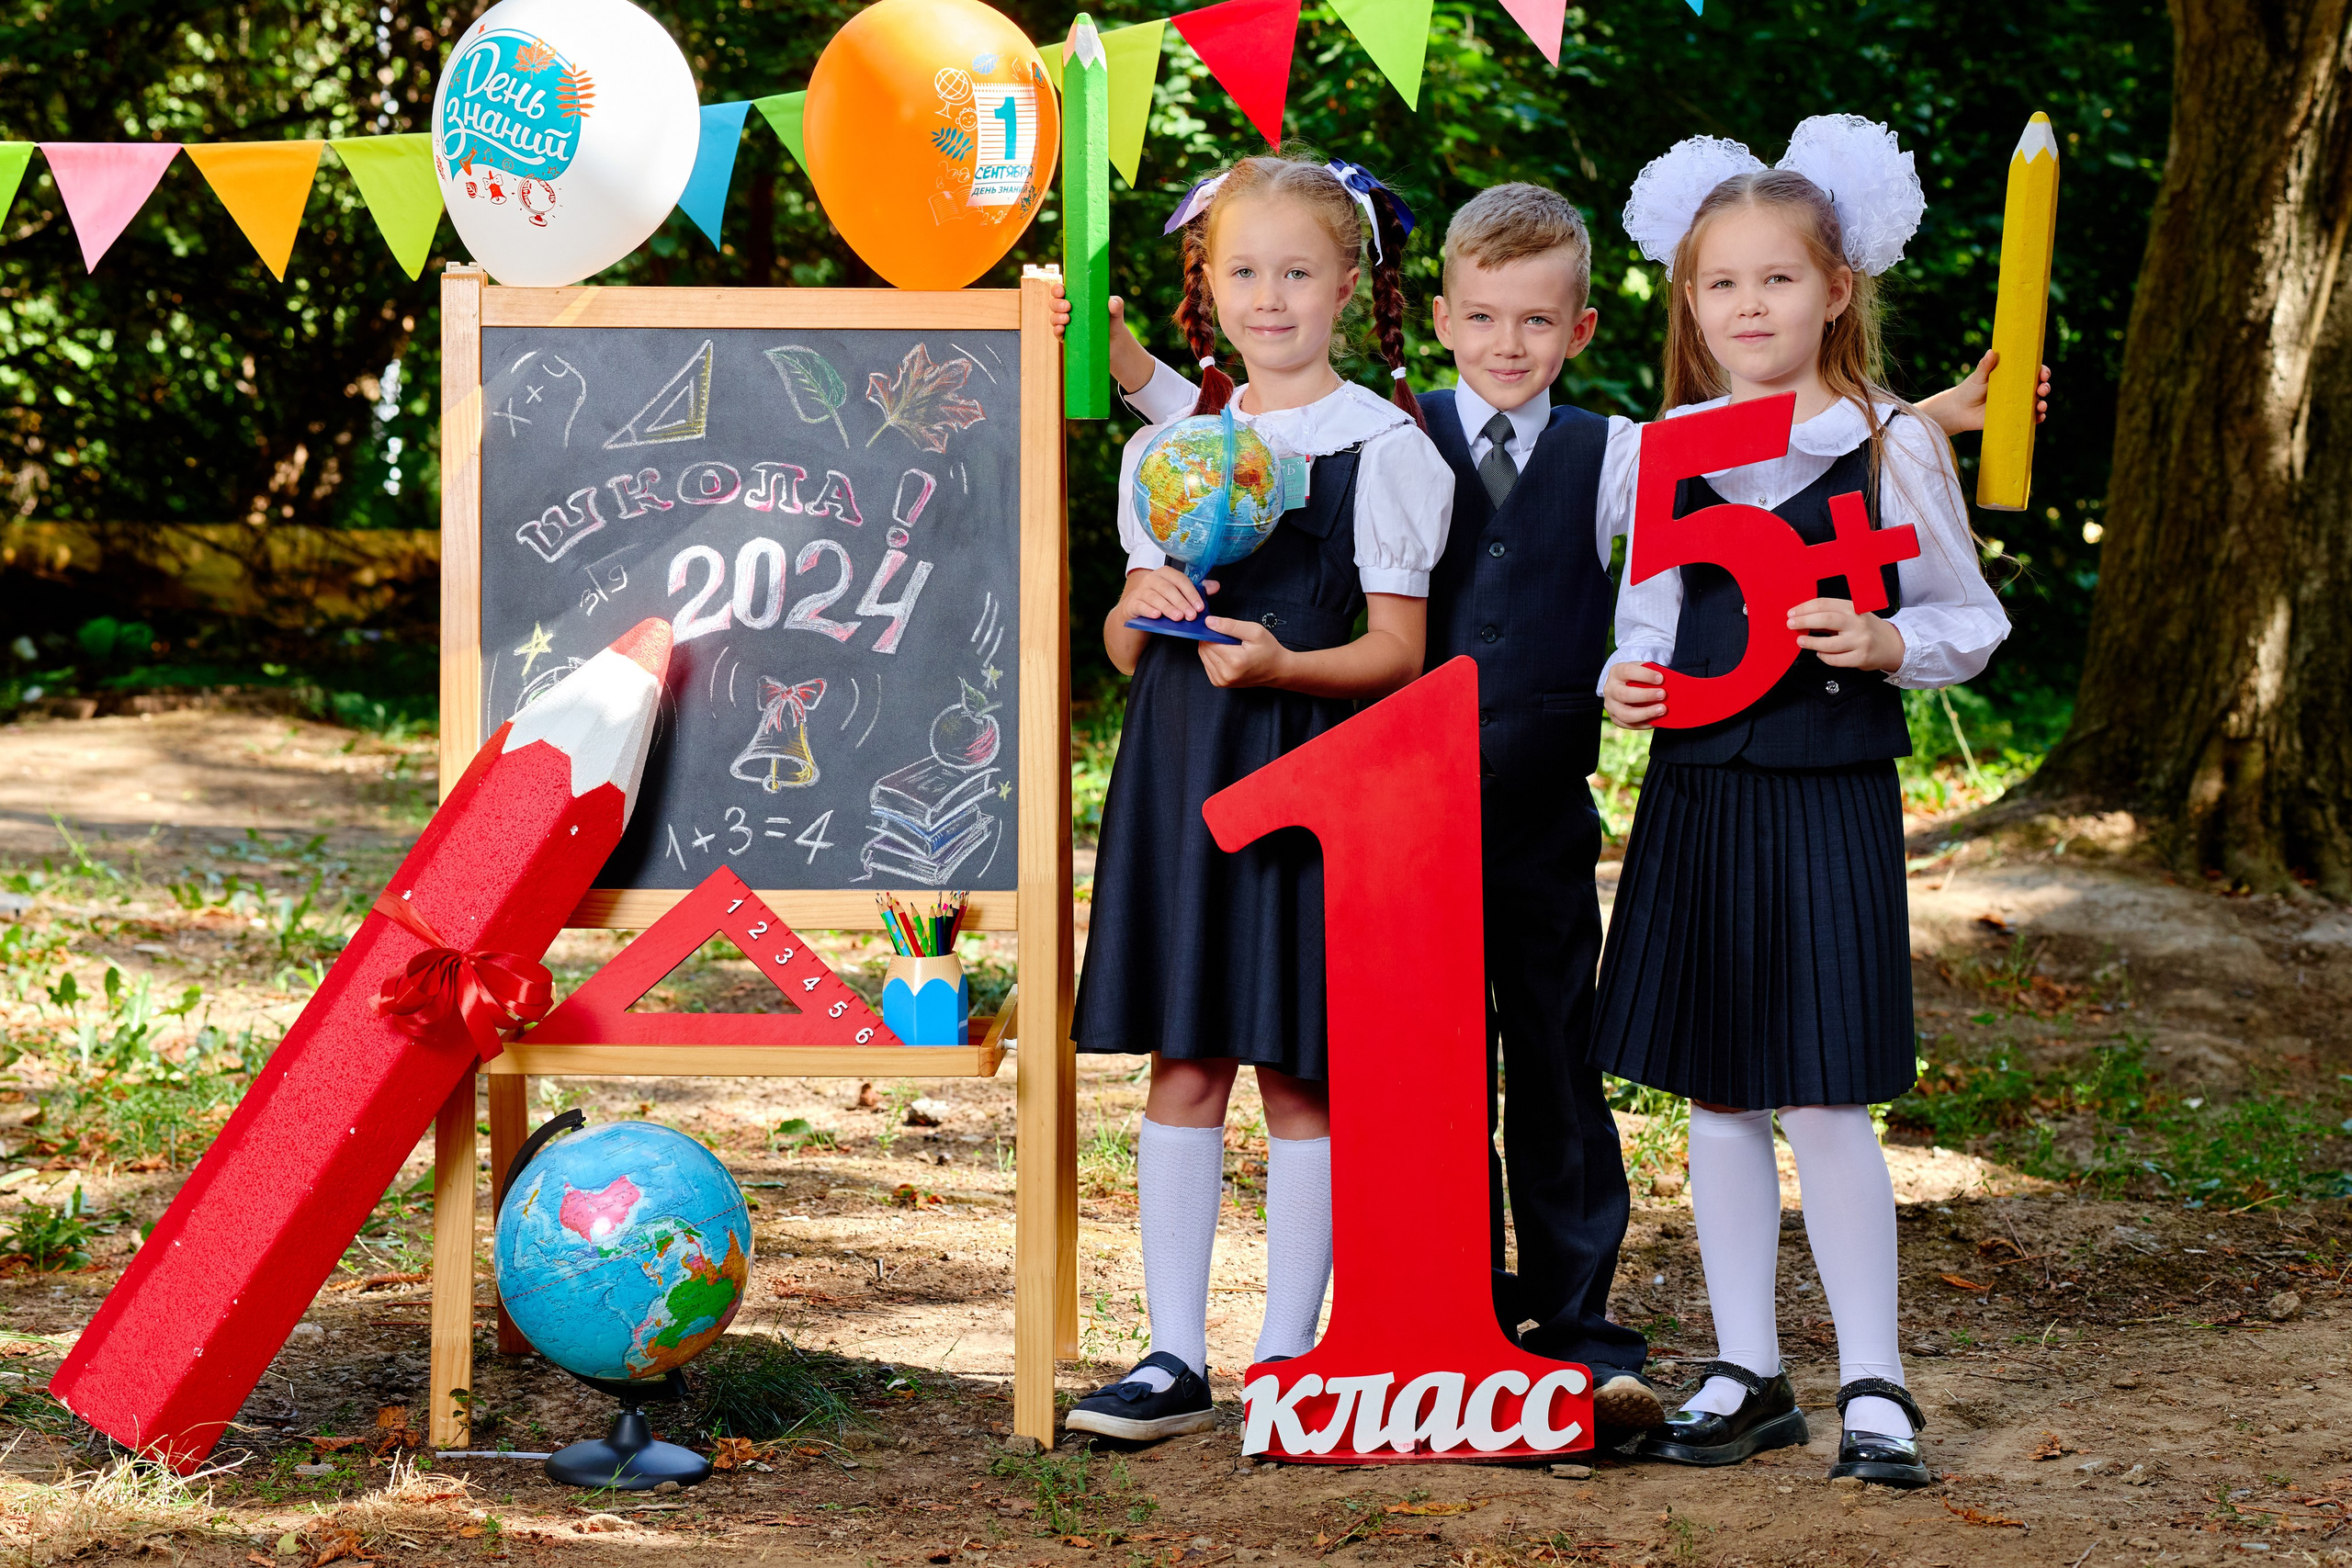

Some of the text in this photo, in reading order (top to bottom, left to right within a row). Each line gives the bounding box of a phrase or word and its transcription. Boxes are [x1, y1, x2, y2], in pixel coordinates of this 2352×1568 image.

[464, 41, 547, 119] День
[442, 96, 573, 164] знаний
[994, 96, 1017, 160] 1
[971, 185, 1028, 197] ДЕНЬ ЗНАНИЙ
[974, 164, 1034, 180] СЕНТЯБРЯ
[667, 536, 934, 655] 2024
[727, 898, 875, 1045] 1 2 3 4 5 6
[1203, 655, 1594, 1462] 1
